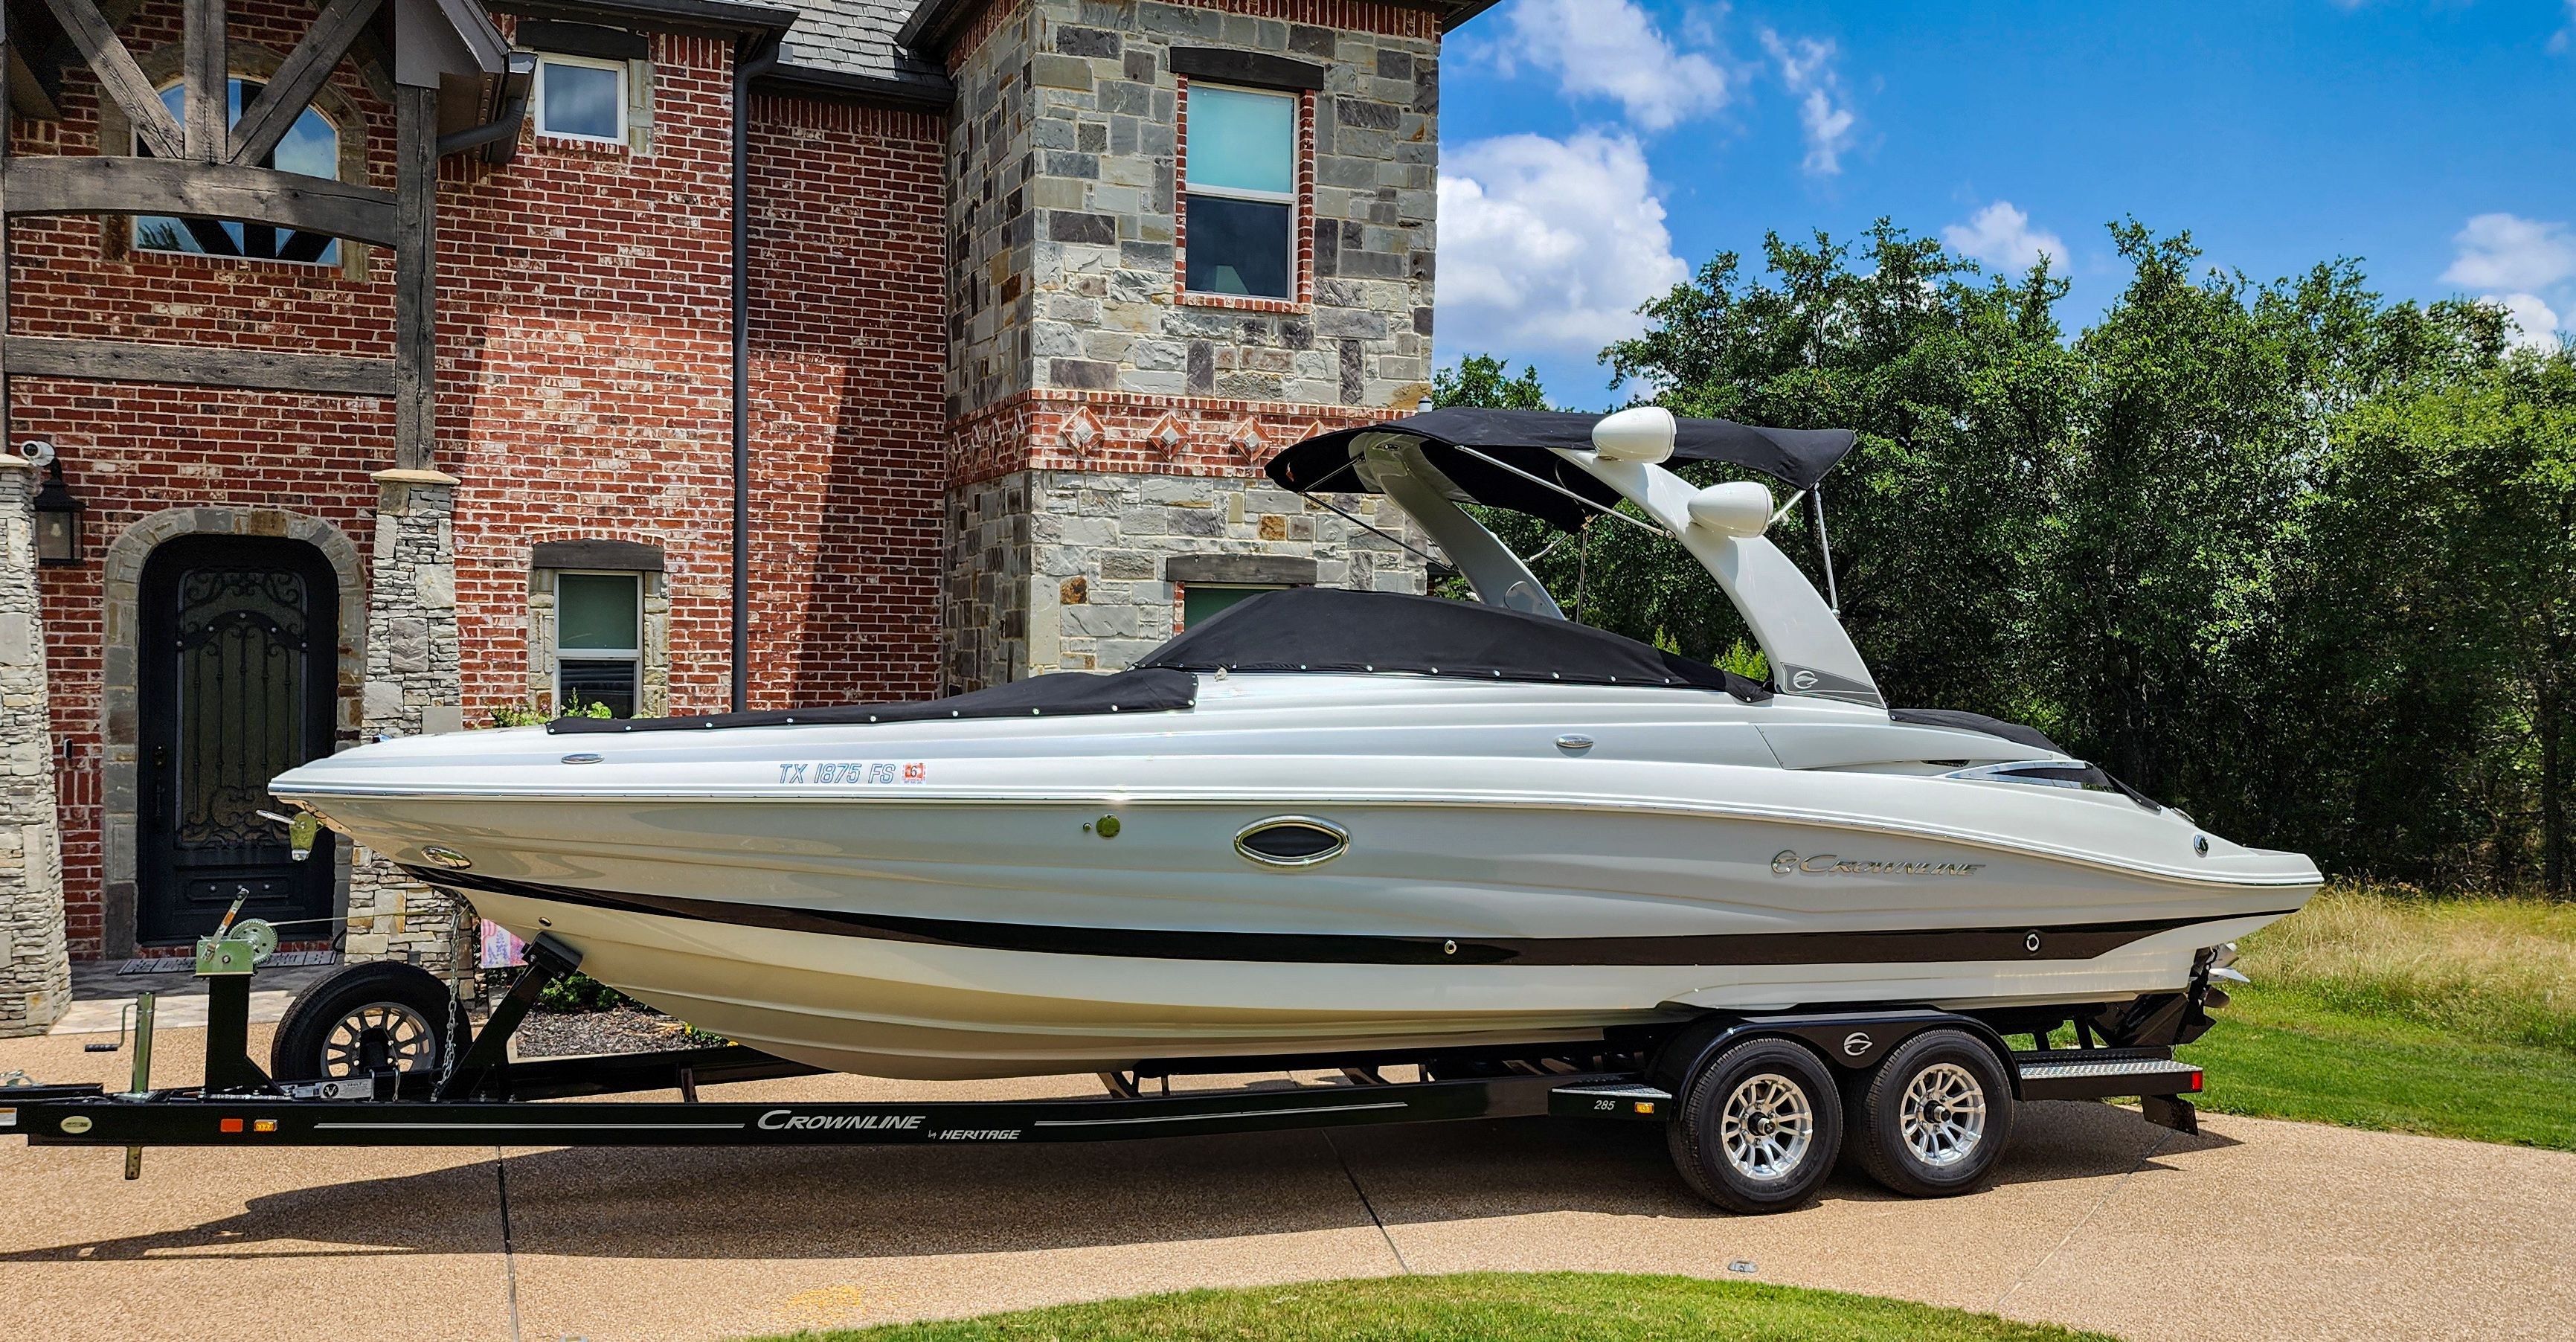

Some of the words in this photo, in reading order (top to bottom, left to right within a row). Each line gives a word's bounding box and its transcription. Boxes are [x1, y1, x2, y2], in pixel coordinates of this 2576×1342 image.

[780, 763, 807, 783] TX
[814, 763, 862, 783] 1875
[867, 763, 896, 783] FS
[1799, 854, 1986, 876] CROWNLINE
[1593, 1099, 1616, 1111] 285
[757, 1109, 926, 1129] CROWNLINE
[928, 1130, 937, 1140] by
[939, 1129, 1021, 1140] HERITAGE
